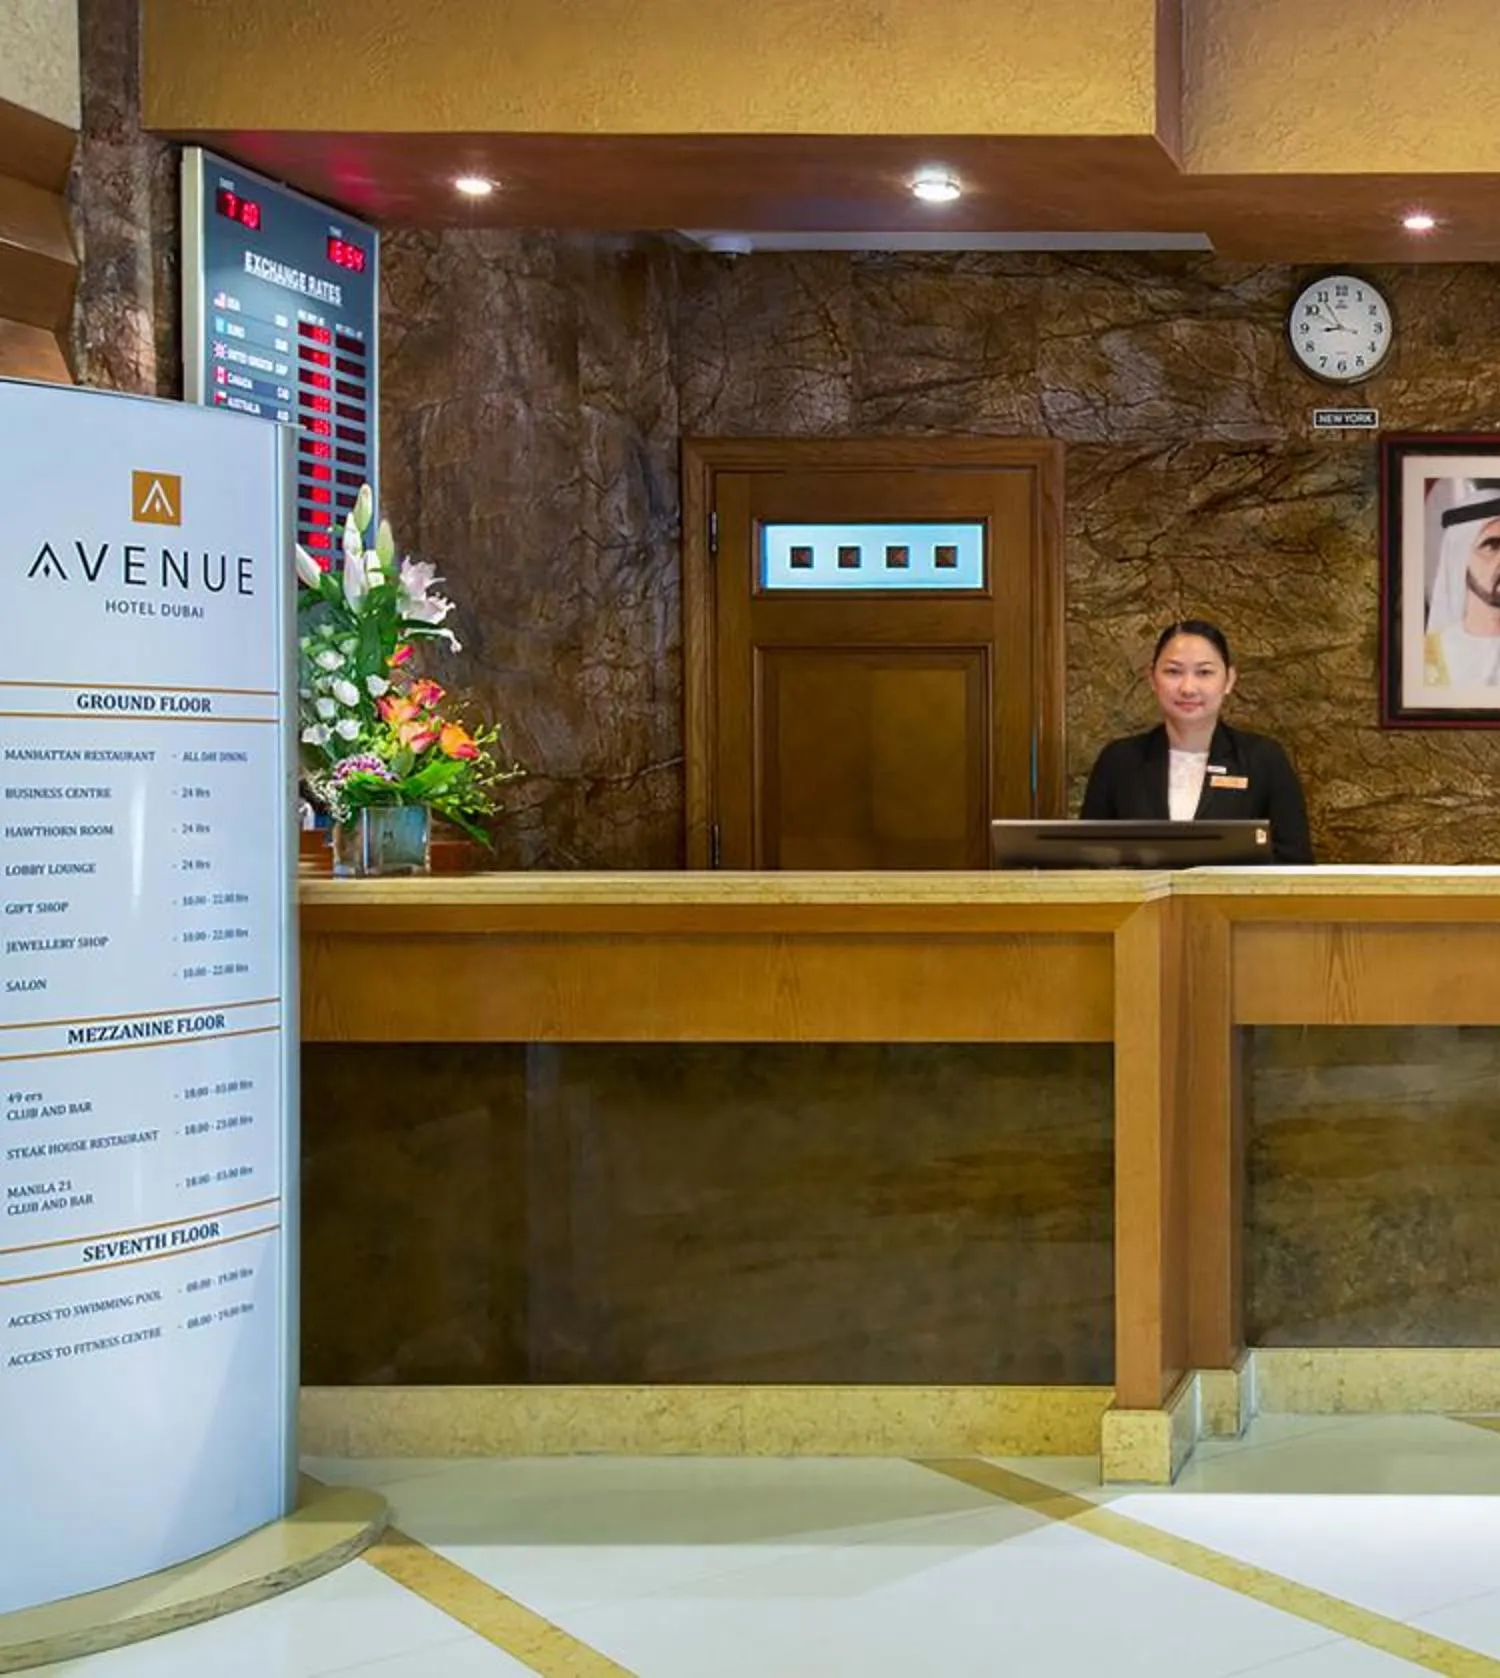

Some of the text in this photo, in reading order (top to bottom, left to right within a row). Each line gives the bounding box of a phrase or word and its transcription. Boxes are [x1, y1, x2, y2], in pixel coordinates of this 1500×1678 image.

[244, 250, 342, 305] EXCHANGE RATES
[1318, 412, 1373, 423] NEW YORK
[27, 541, 254, 596] AVENUE
[105, 599, 204, 619] HOTEL DUBAI
[77, 693, 212, 713] GROUND FLOOR
[5, 749, 156, 762] MANHATTAN RESTAURANT
[182, 751, 199, 762] ALL
[5, 787, 112, 799] BUSINESS CENTRE
[181, 787, 193, 799] 24
[5, 824, 115, 838] HAWTHORN ROOM
[181, 823, 193, 835] 24
[5, 862, 97, 877] LOBBY LOUNGE
[181, 859, 193, 871] 24
[5, 900, 69, 915] GIFT SHOP
[6, 935, 110, 953] JEWELLERY SHOP
[5, 978, 47, 992] SALON
[67, 1014, 225, 1045] MEZZANINE FLOOR
[7, 1101, 92, 1122] CLUB AND BAR
[7, 1130, 160, 1160] STEAK HOUSE RESTAURANT
[7, 1180, 72, 1199] MANILA 21
[7, 1193, 94, 1216] CLUB AND BAR
[82, 1222, 221, 1263] SEVENTH FLOOR
[8, 1290, 163, 1328] ACCESS TO SWIMMING POOL
[8, 1325, 162, 1368] ACCESS TO FITNESS CENTRE
